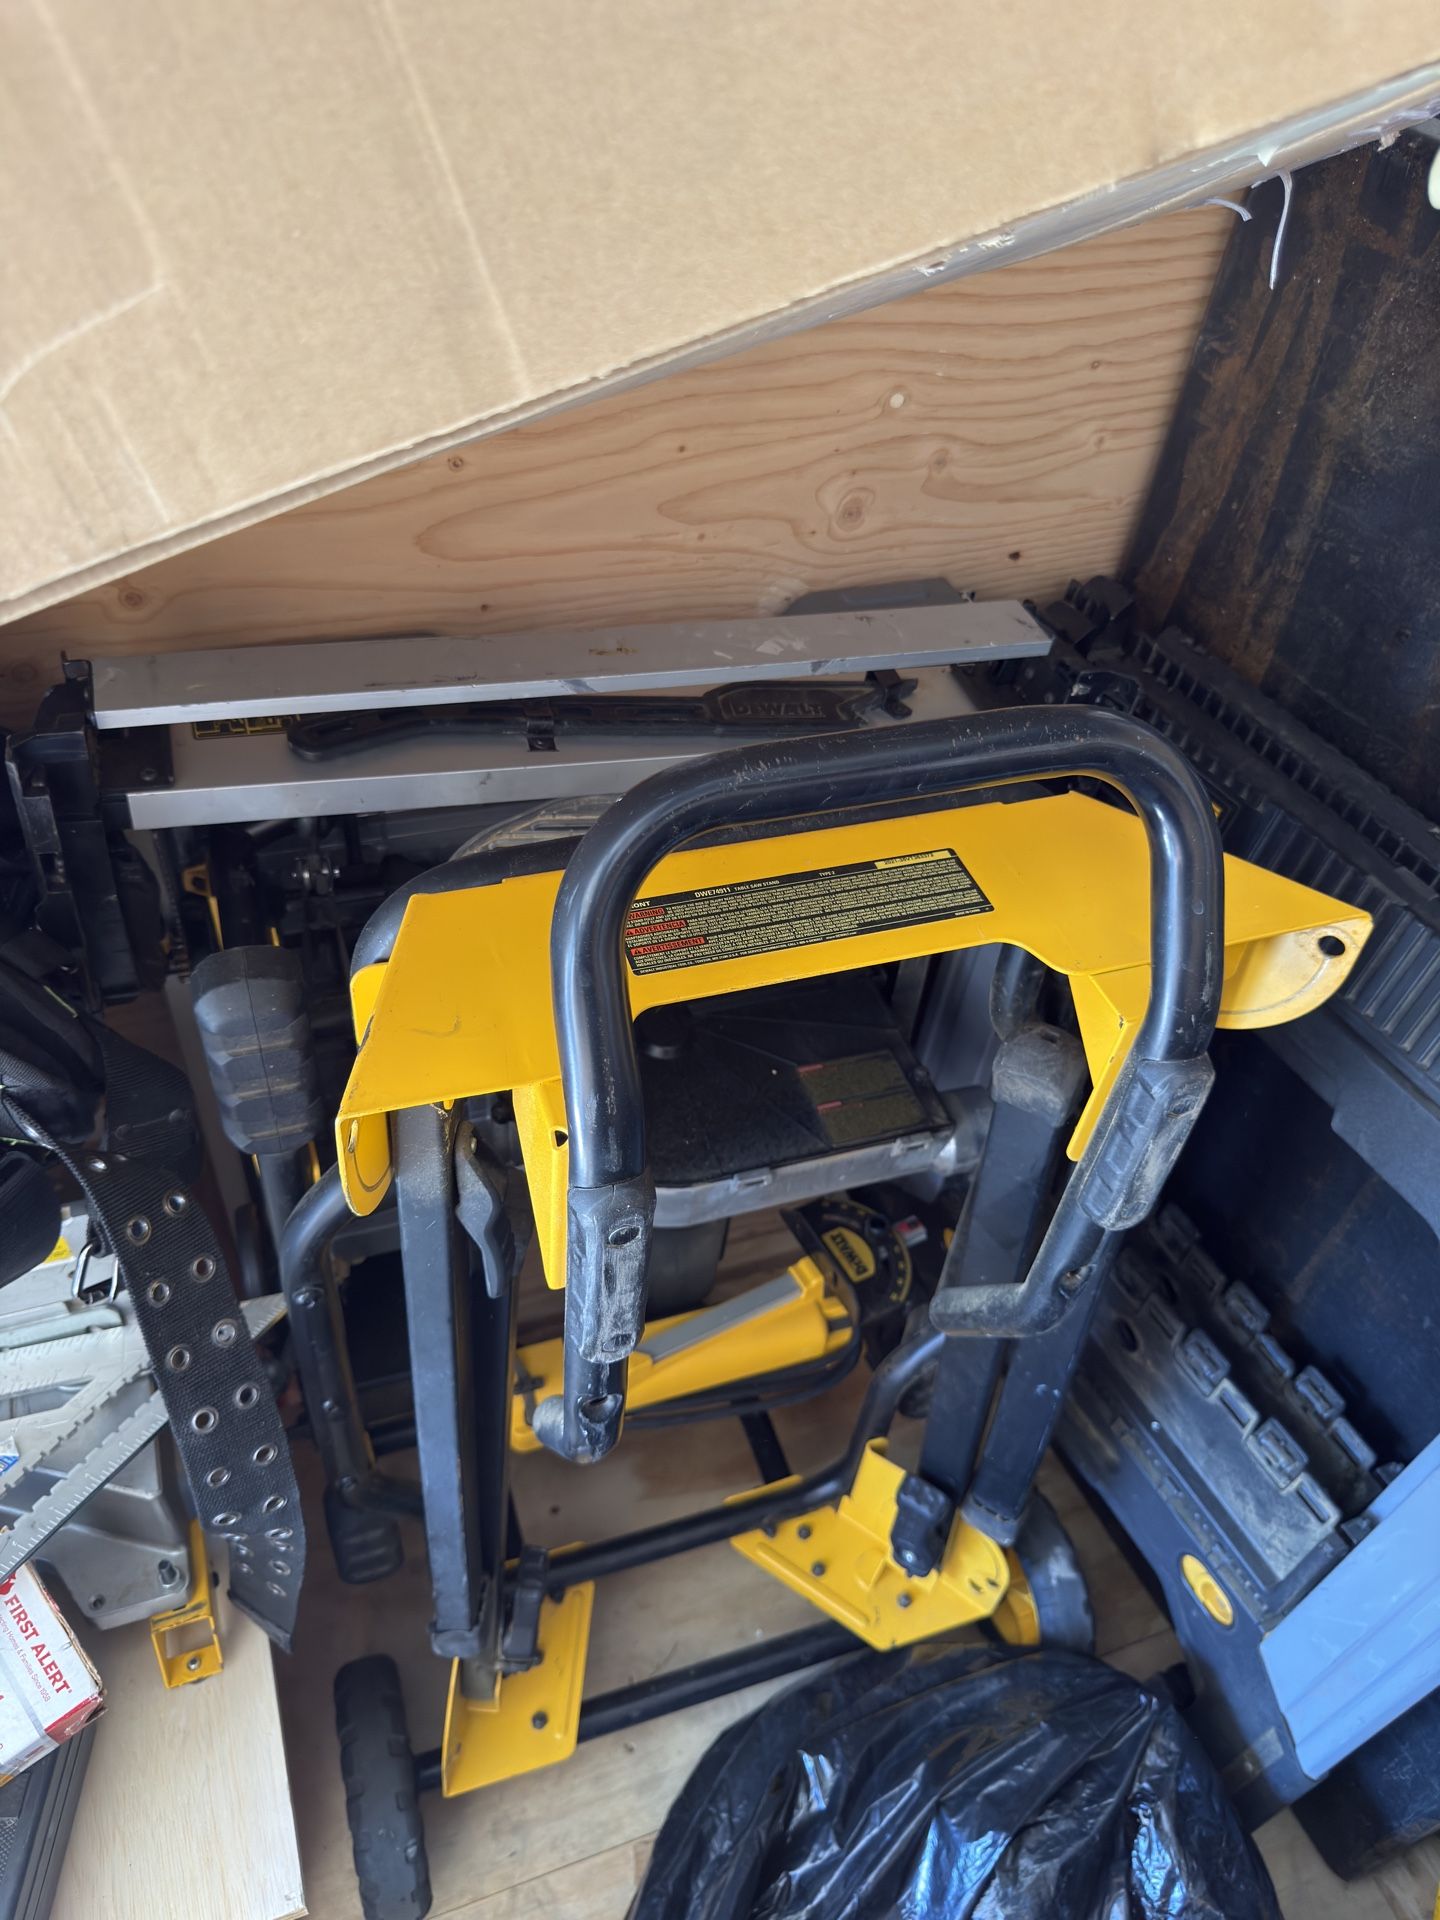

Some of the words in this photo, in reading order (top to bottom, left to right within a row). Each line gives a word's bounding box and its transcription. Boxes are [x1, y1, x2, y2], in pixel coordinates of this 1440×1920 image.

[630, 900, 651, 908] ONT
[694, 887, 730, 897] DWE74911
[627, 908, 663, 919] WARNING
[634, 920, 684, 934] ADVERTENCIA
[642, 937, 703, 954] AVERTISSEMENT
[4, 1594, 40, 1642] FIRST
[31, 1643, 71, 1694] ALERT
[6, 1630, 20, 1649] Homes
[20, 1654, 34, 1674] Families
[31, 1673, 42, 1688] Since
